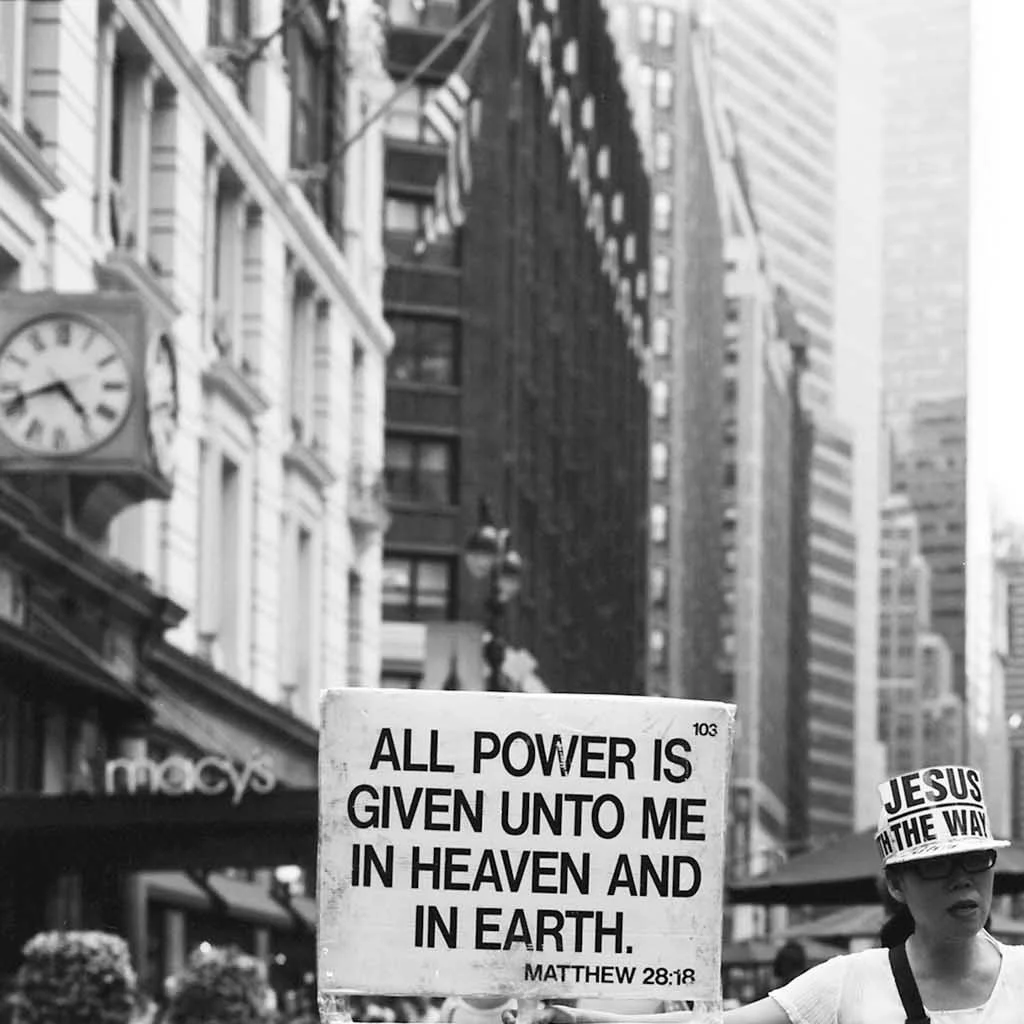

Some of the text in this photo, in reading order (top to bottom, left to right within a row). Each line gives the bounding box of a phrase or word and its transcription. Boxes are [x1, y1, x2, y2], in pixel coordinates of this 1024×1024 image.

[693, 723, 717, 736] 103
[370, 728, 692, 783] ALL POWER IS
[347, 784, 706, 841] GIVEN UNTO ME
[884, 767, 982, 814] JESUS
[890, 813, 937, 851] THE
[942, 809, 988, 838] WAY
[352, 844, 701, 897] IN HEAVEN AND
[415, 905, 632, 953] IN EARTH.
[525, 963, 695, 985] MATTHEW 28:18
